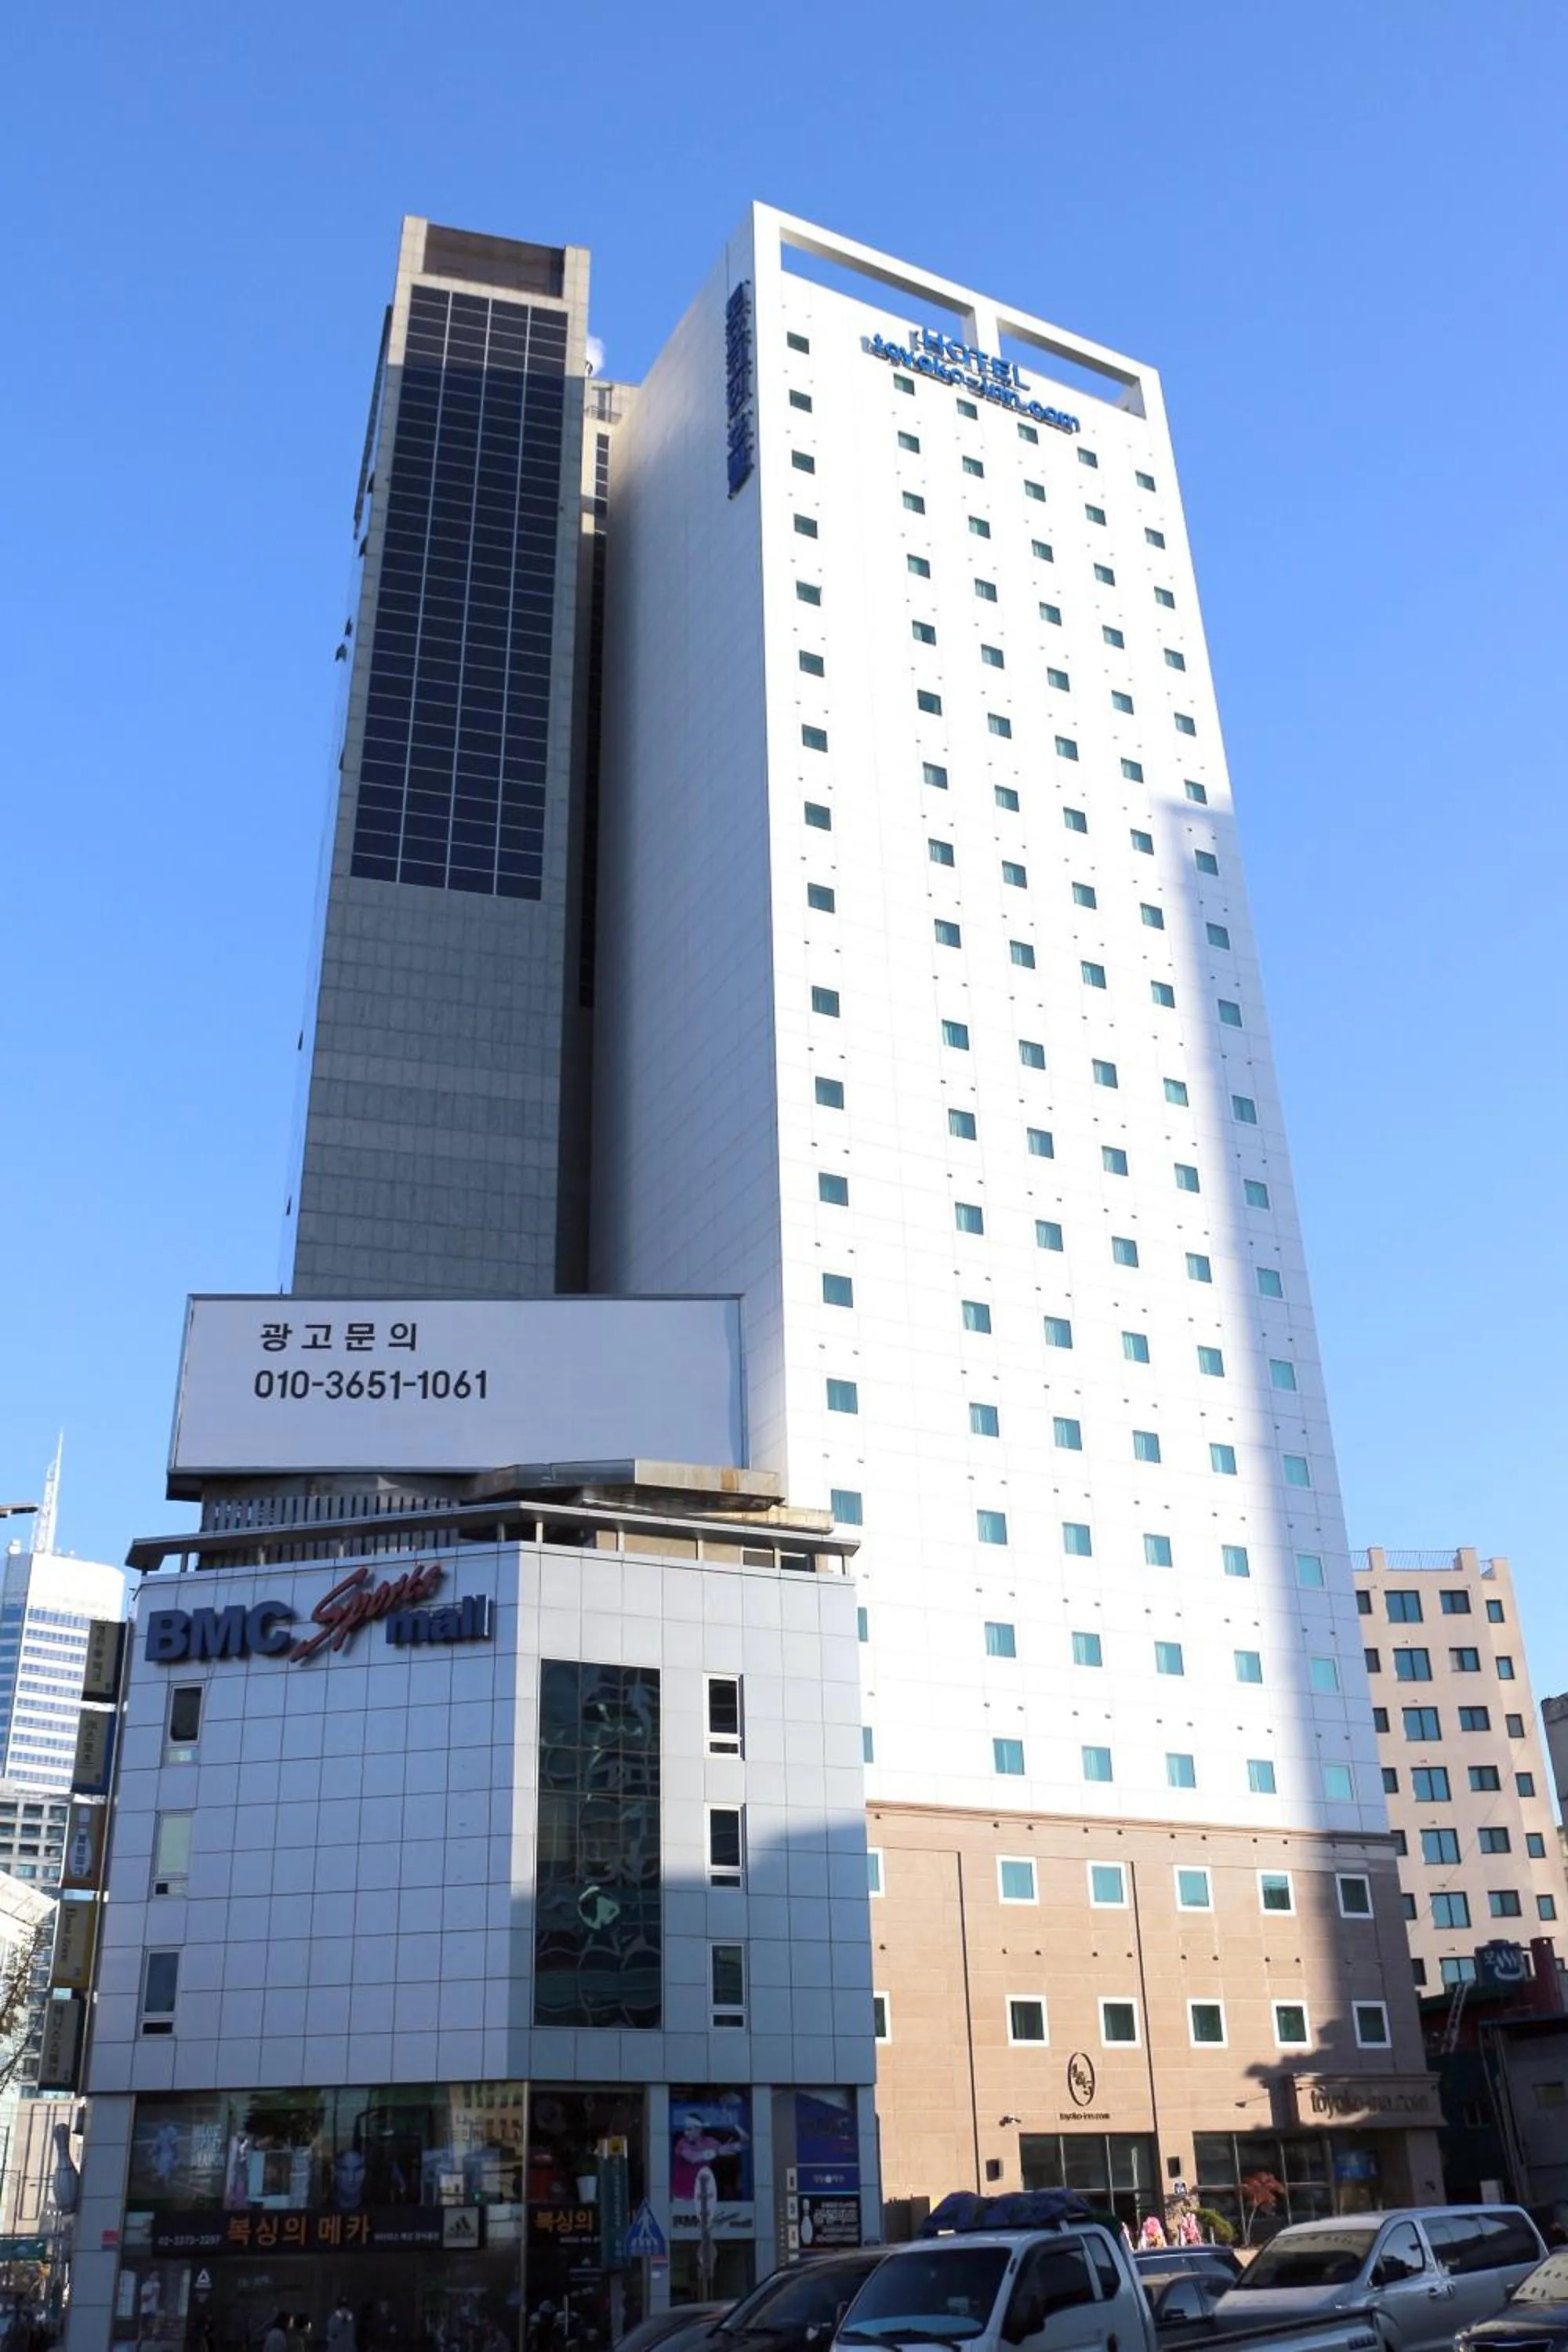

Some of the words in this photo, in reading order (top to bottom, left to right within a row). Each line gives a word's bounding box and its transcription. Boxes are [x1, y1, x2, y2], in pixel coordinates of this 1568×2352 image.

[920, 327, 1030, 390] HOTEL
[872, 333, 1080, 434] toyoko-inn.com
[253, 1370, 488, 1399] 010-3651-1061
[144, 1601, 294, 1661] BMC
[289, 1566, 443, 1662] Sports
[387, 1595, 489, 1644] mall
[1311, 2089, 1428, 2118] toyoko-inn.com
[228, 2215, 307, 2247] 복싱의
[318, 2213, 372, 2245] 메카
[534, 2209, 594, 2234] 복싱의
